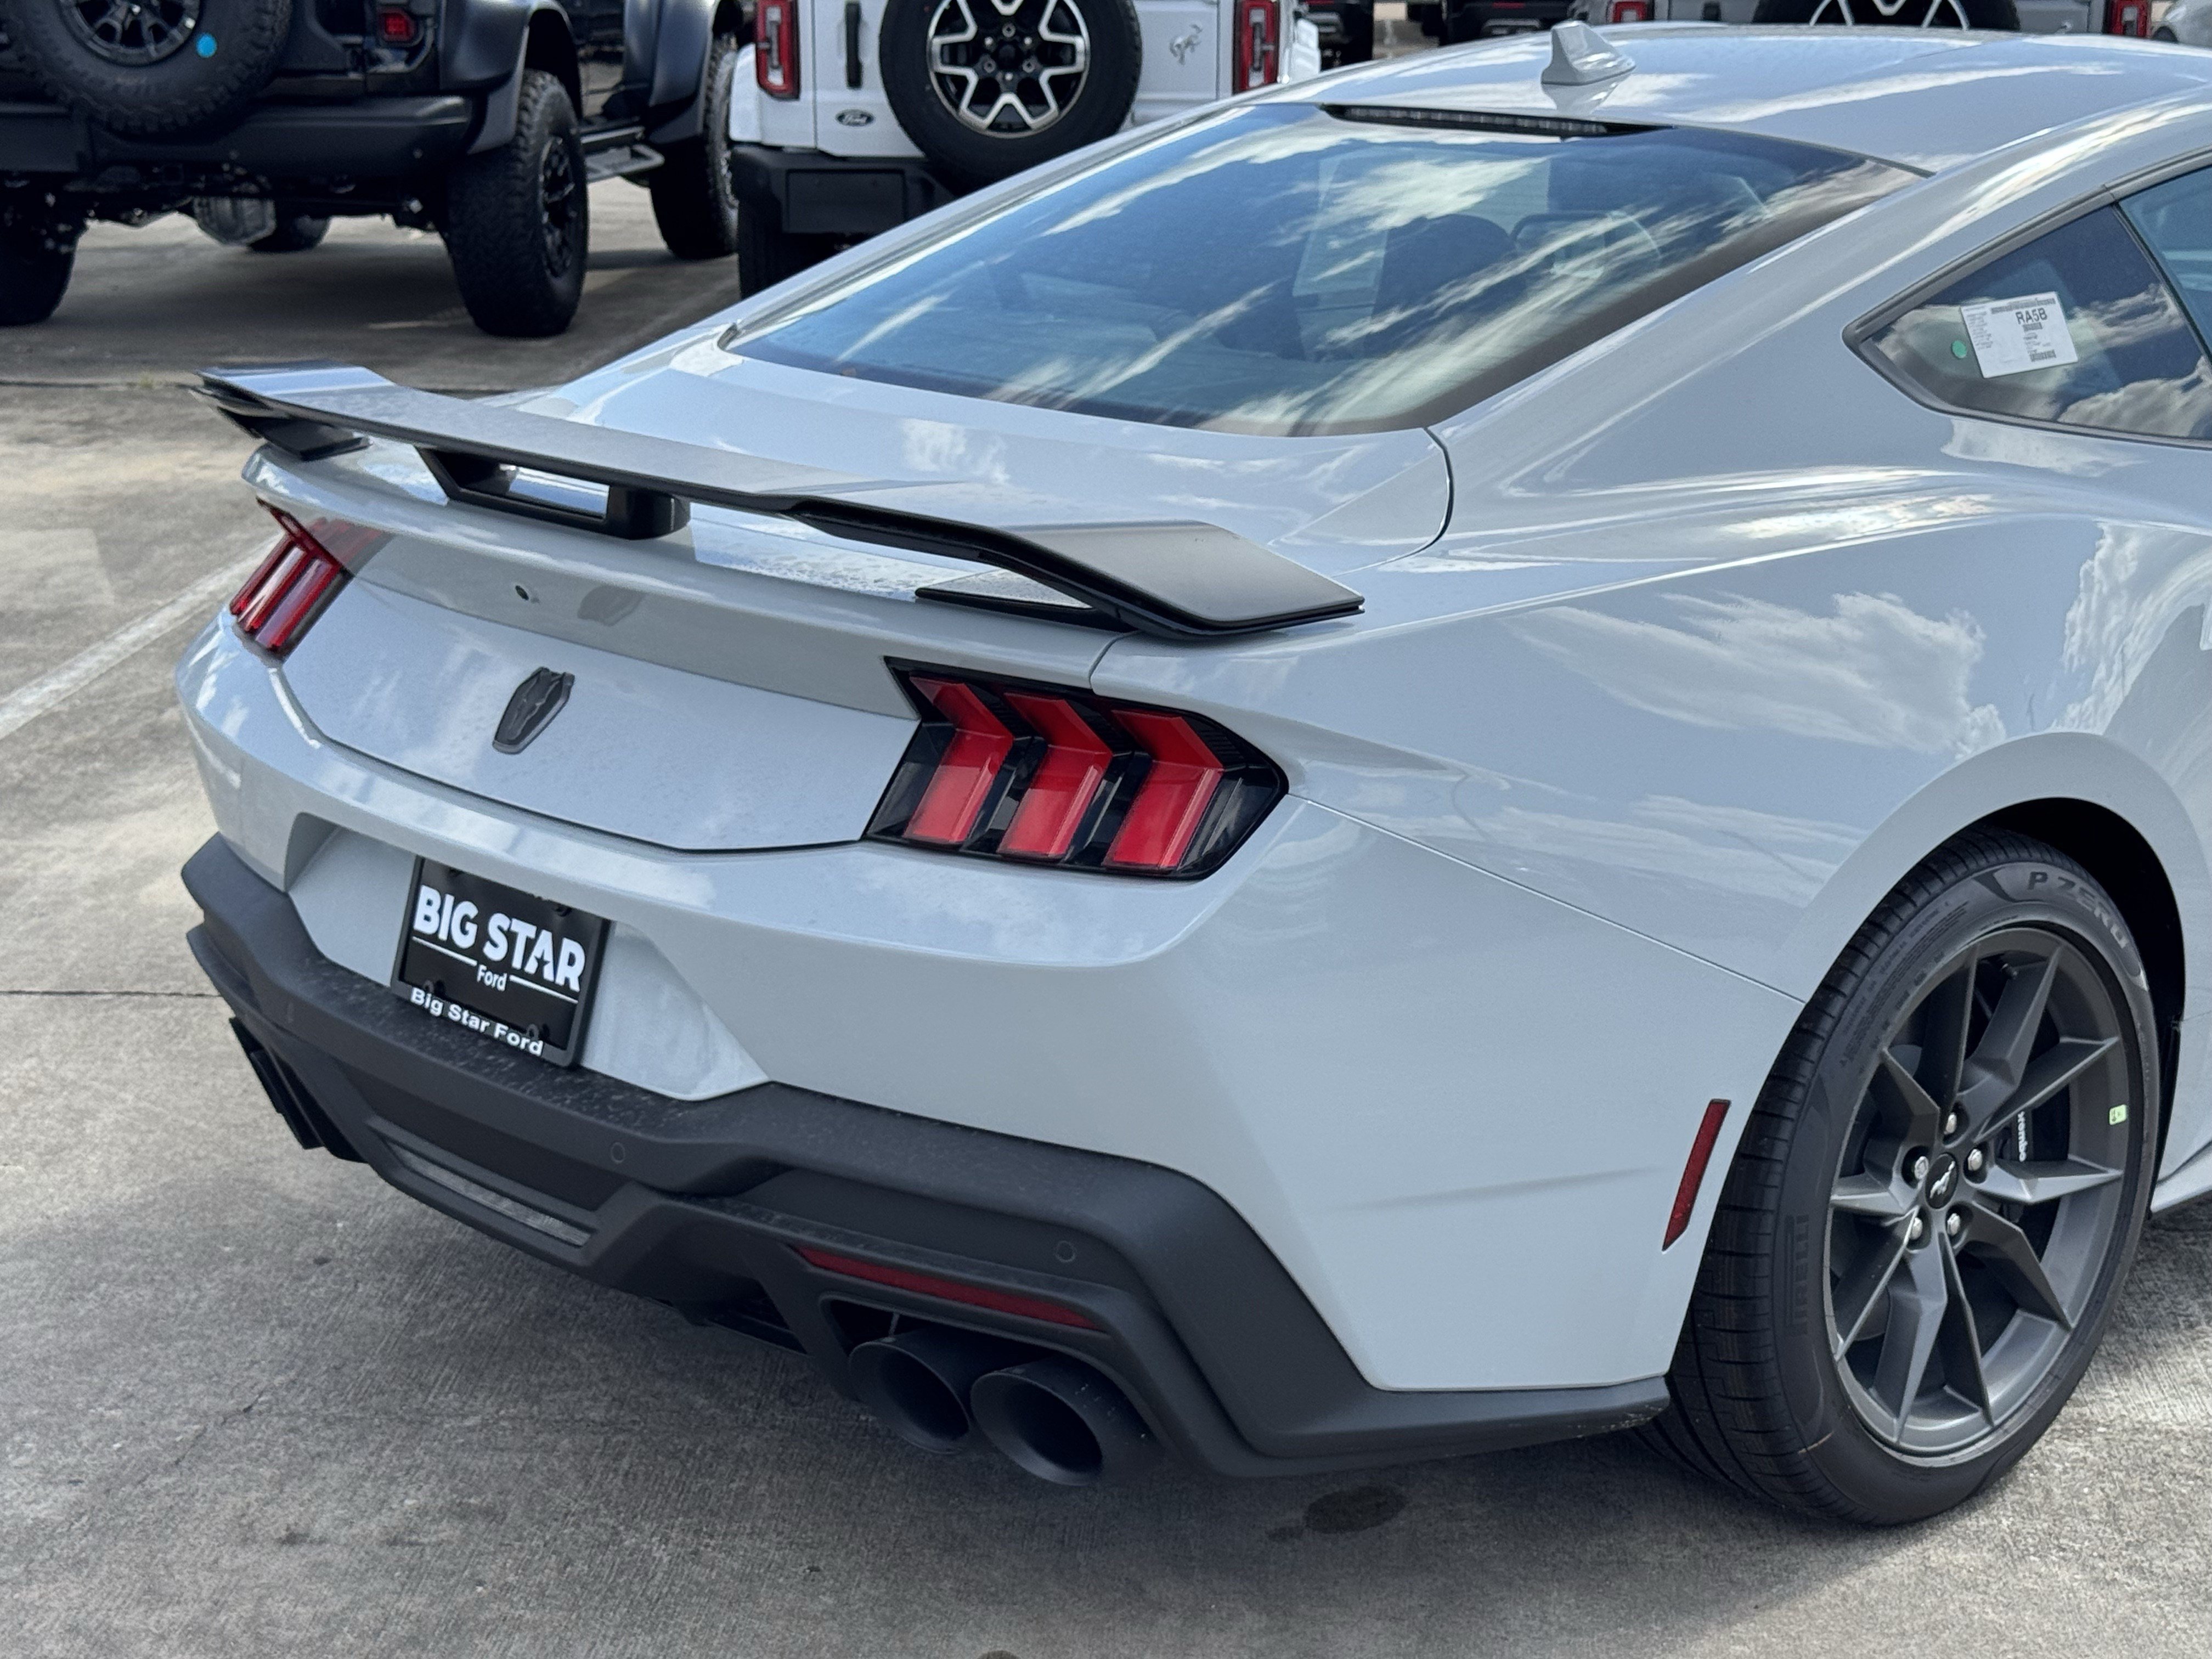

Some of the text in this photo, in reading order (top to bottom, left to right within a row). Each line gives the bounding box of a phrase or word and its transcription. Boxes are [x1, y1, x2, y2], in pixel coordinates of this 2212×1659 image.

[2015, 307, 2048, 325] RA5B
[414, 885, 585, 992] BIG STAR
[2028, 871, 2129, 949] P ZERO
[477, 964, 507, 991] Ford
[410, 988, 544, 1056] Big Star Ford
